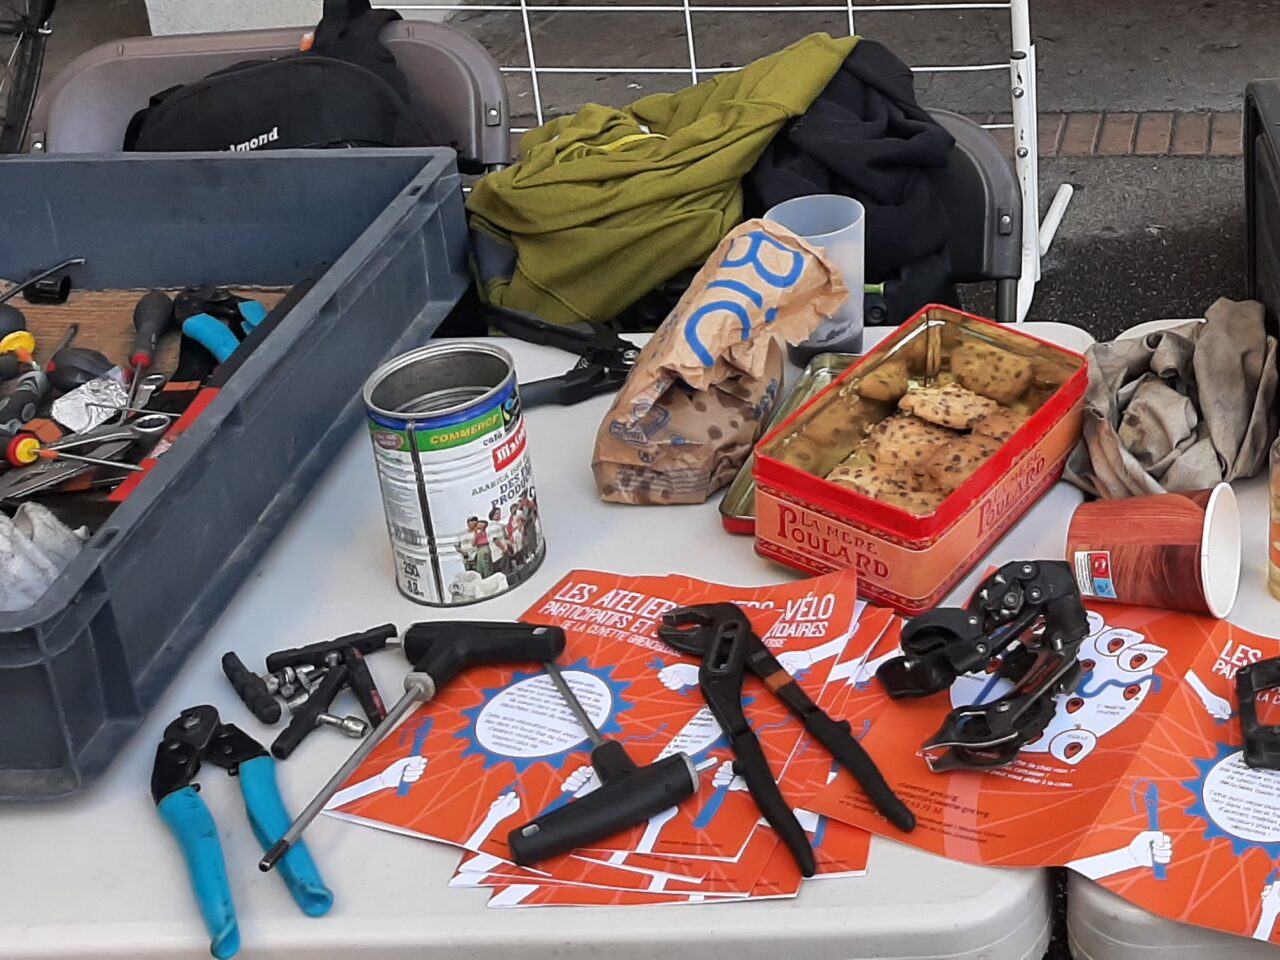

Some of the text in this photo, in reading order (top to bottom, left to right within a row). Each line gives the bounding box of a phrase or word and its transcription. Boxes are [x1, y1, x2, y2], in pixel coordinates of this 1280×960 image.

[777, 503, 890, 579] POULARD
[538, 600, 656, 634] PARTICIPATIFS ET
[553, 581, 686, 619] LES ATELIER
[1219, 639, 1264, 667] LES
